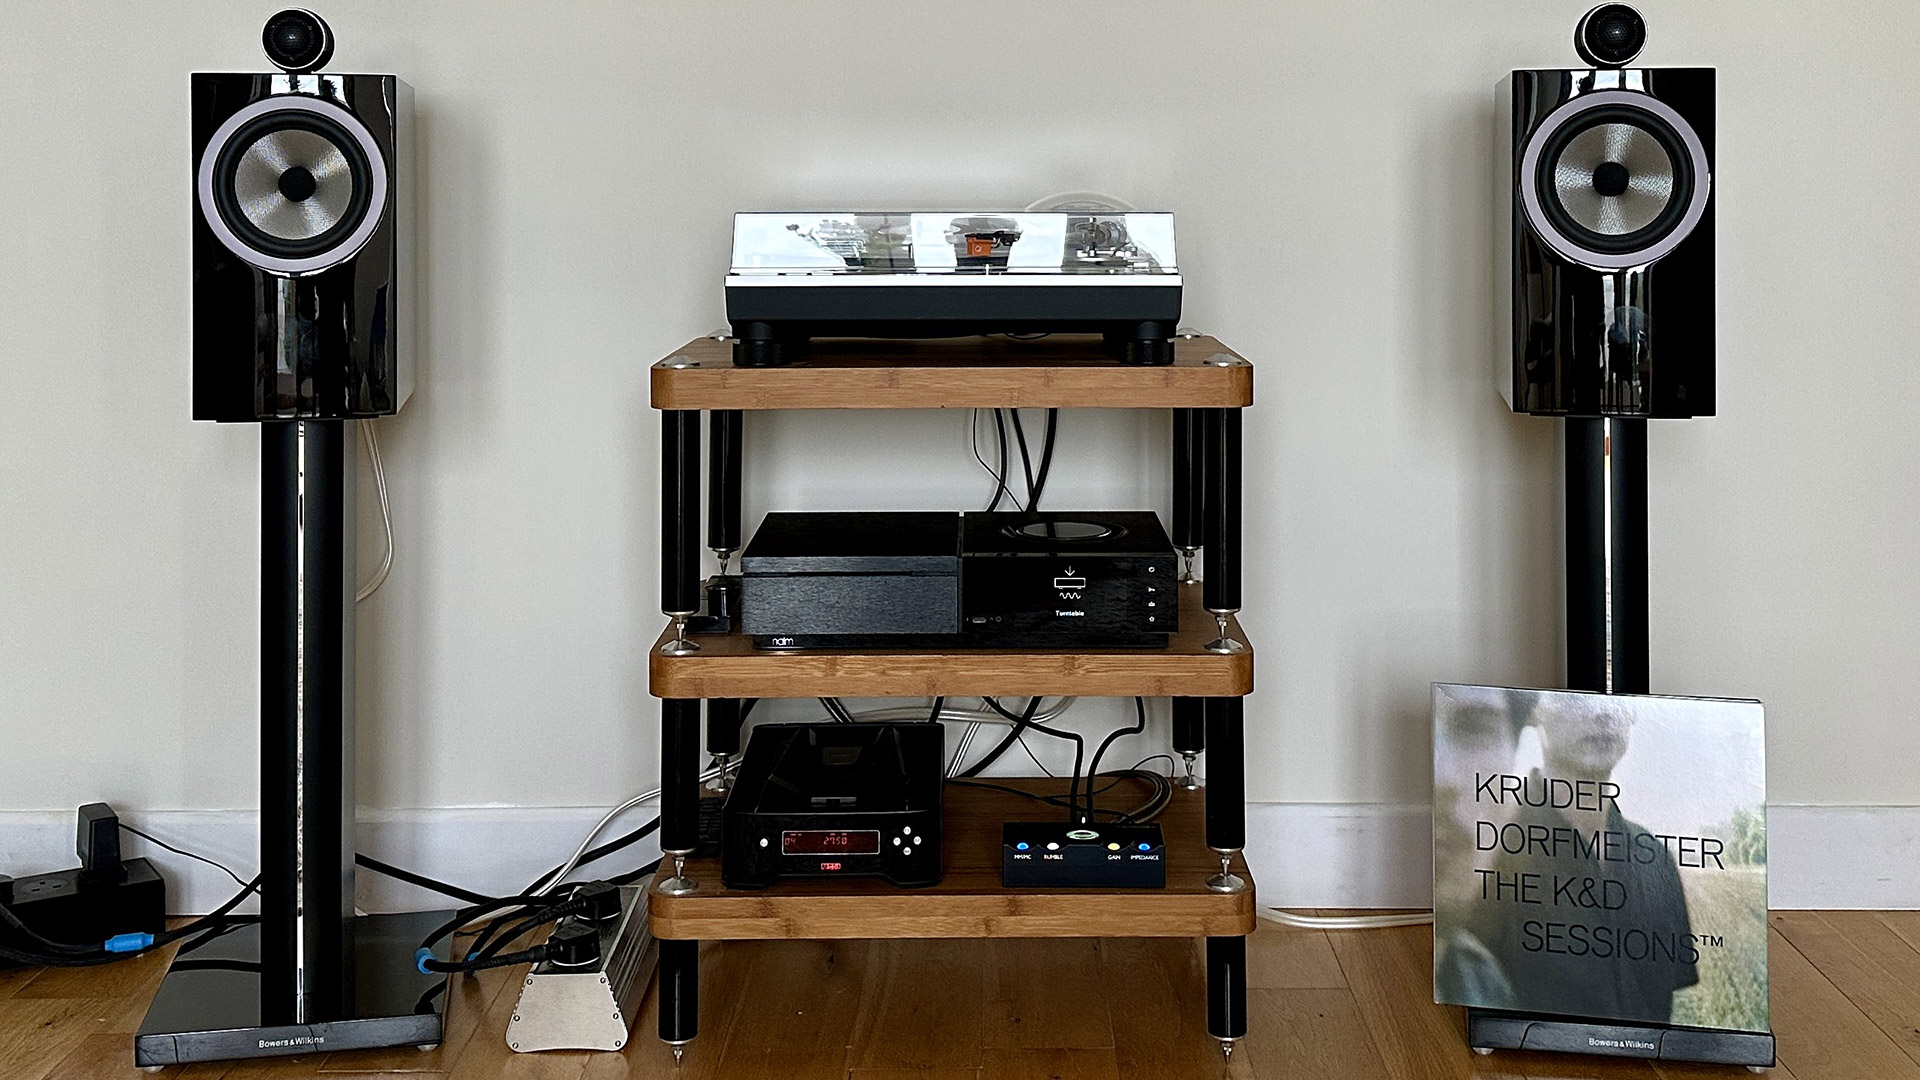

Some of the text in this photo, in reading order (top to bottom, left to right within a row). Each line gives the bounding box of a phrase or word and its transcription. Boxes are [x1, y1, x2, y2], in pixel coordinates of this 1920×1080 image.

[772, 637, 794, 646] naim
[1475, 772, 1622, 814] KRUDER
[1130, 853, 1159, 861] IMPEDANCE
[1476, 821, 1725, 870] DORFMEISTER
[1474, 869, 1628, 910] THE K&D
